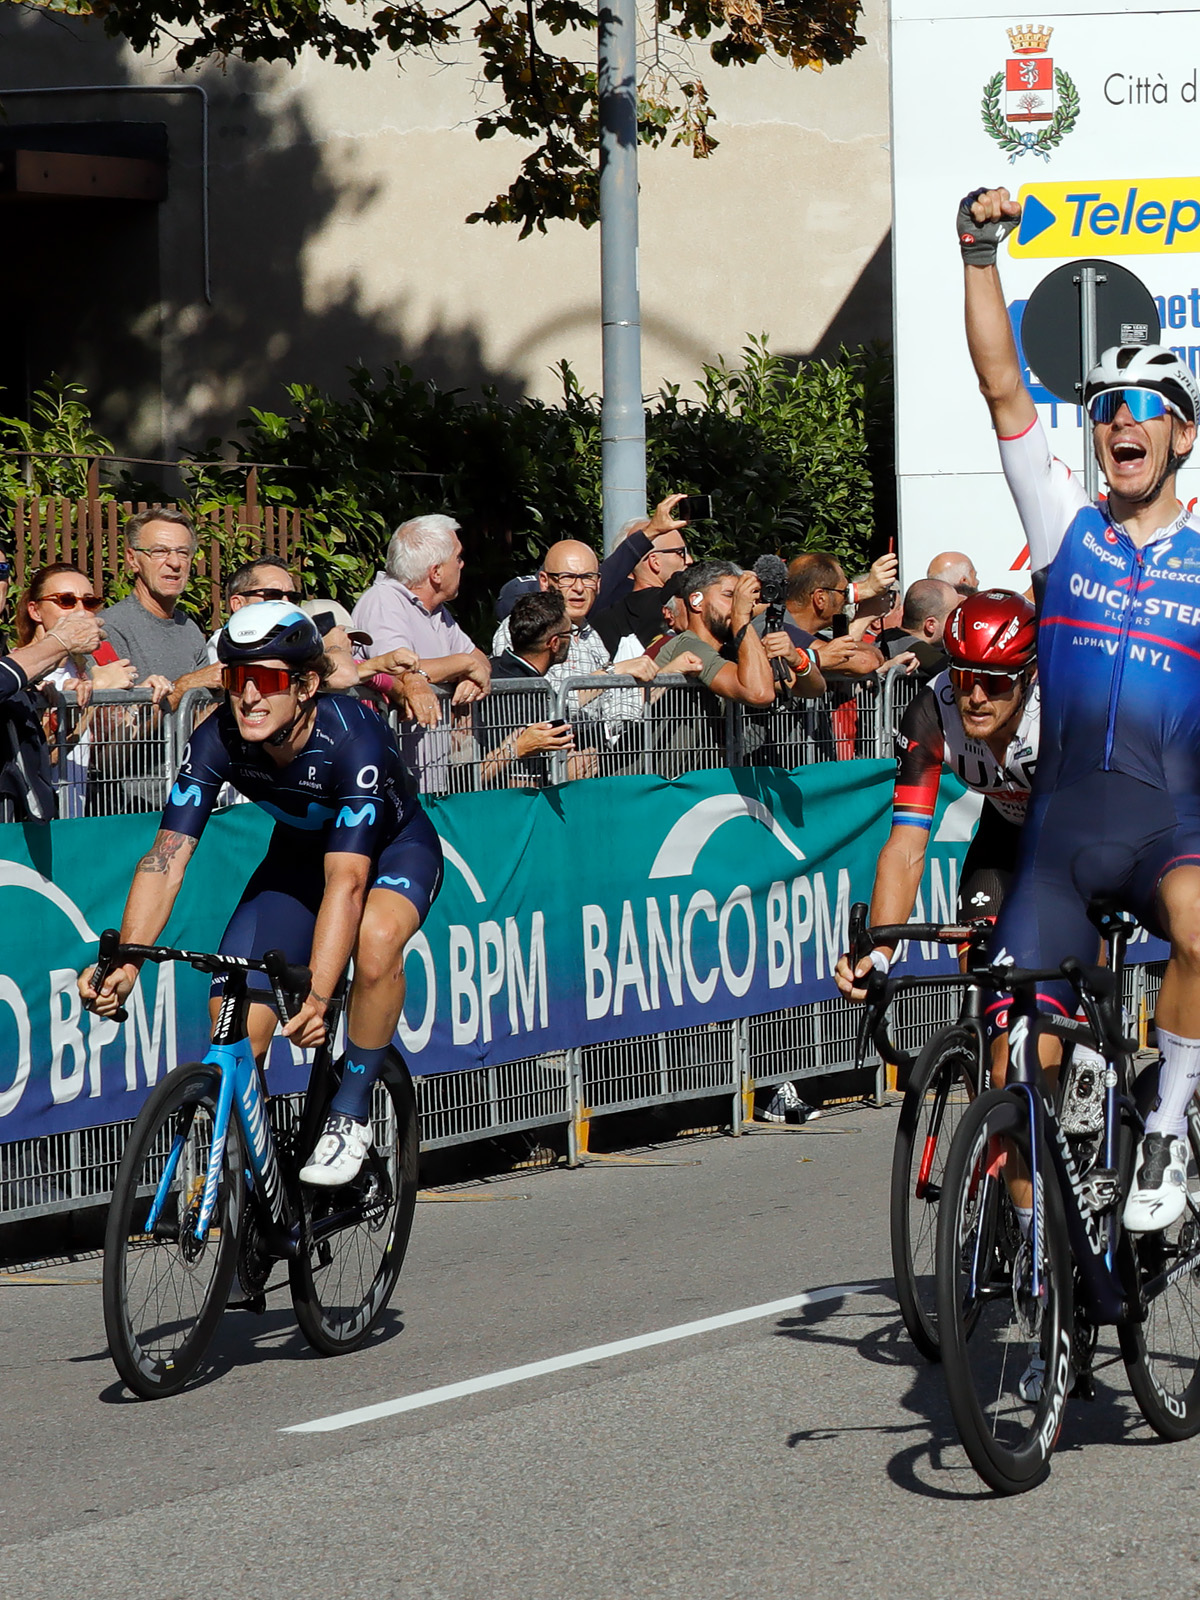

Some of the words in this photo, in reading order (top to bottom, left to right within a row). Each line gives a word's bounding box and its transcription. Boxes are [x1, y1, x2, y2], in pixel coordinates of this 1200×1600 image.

[1103, 71, 1169, 106] Città
[1081, 531, 1128, 572] Ekopak
[448, 910, 549, 1047] BPM
[581, 884, 757, 1021] BANCO
[766, 868, 851, 990] BPM
